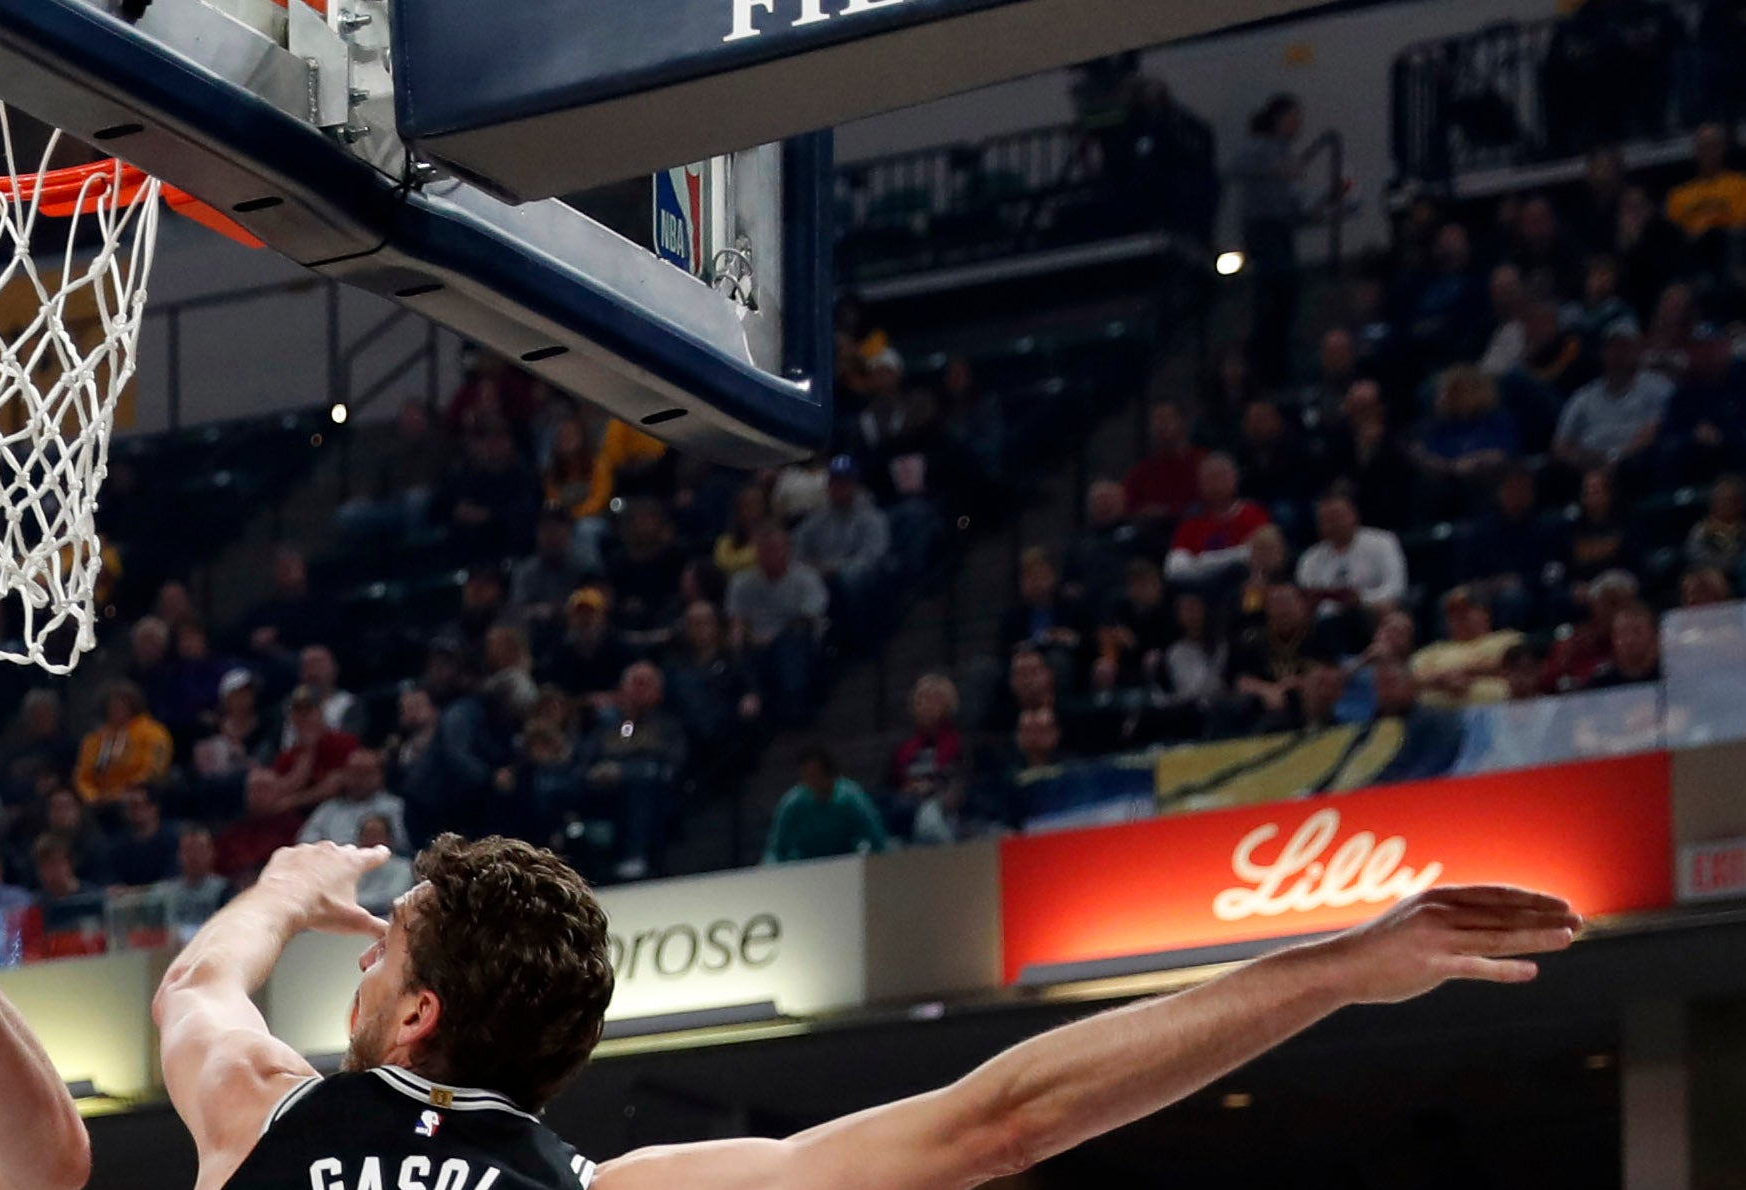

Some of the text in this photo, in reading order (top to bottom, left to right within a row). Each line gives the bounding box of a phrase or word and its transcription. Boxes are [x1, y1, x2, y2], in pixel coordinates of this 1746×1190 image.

[661, 208, 686, 258] NBA
[1212, 807, 1444, 921] Lilly
[608, 912, 783, 982] rose
